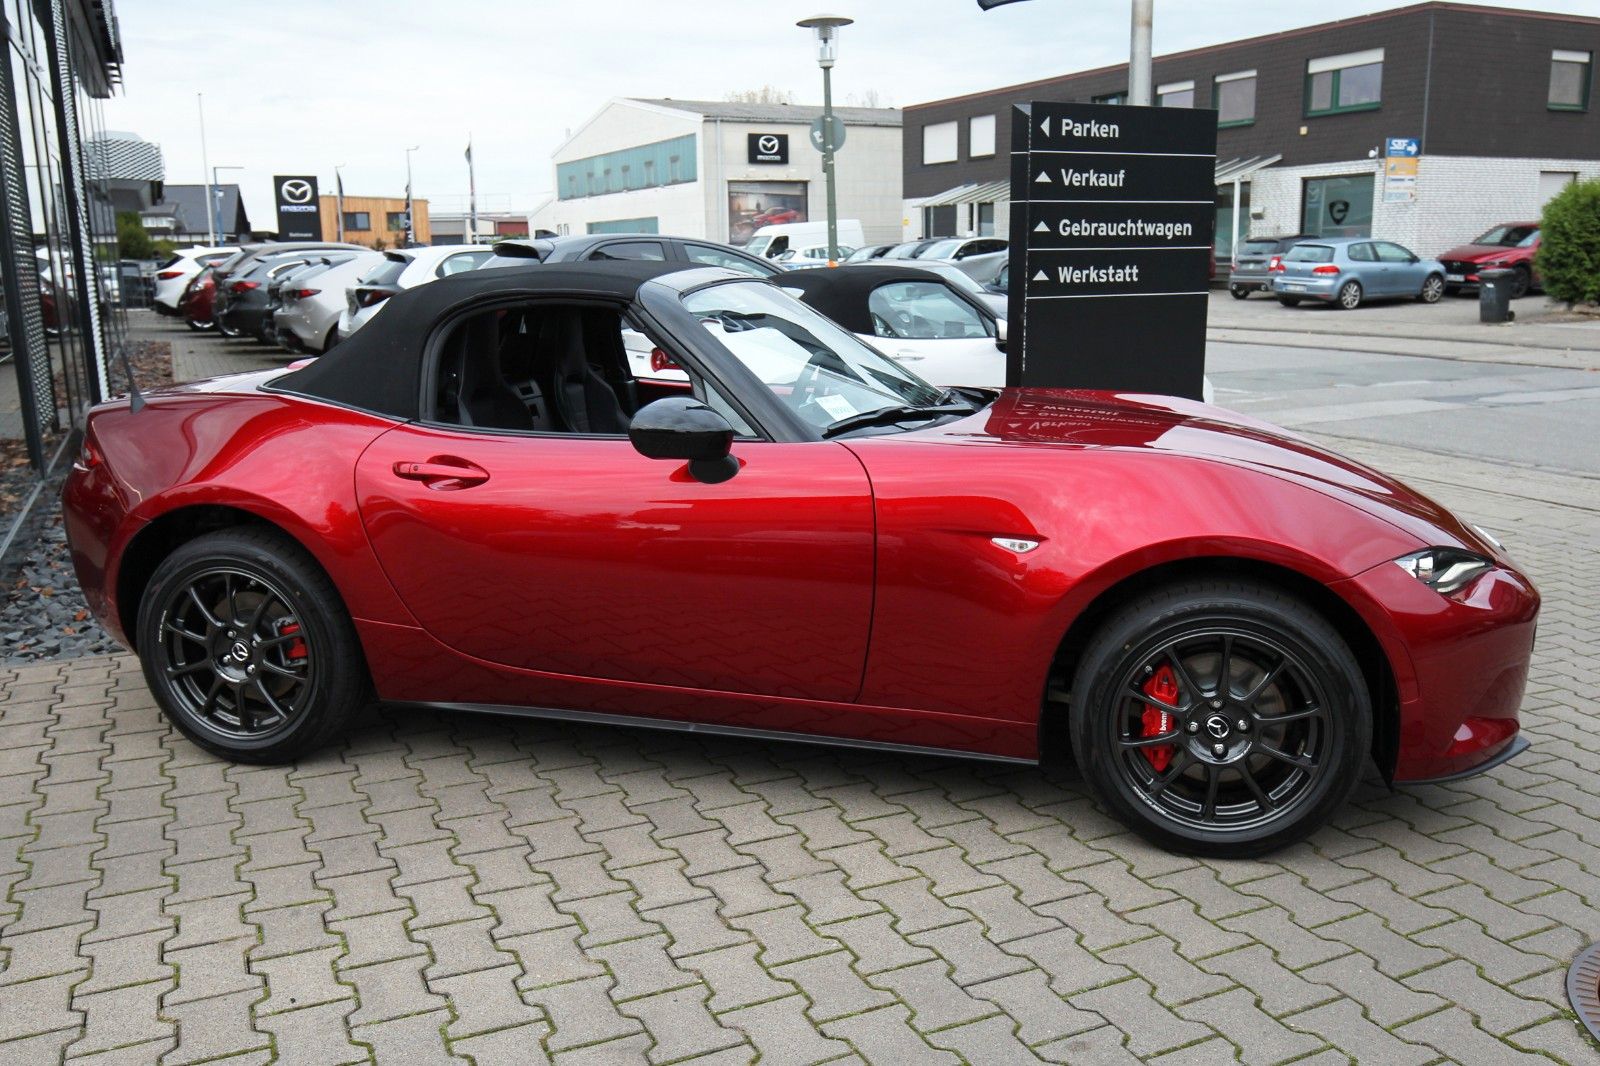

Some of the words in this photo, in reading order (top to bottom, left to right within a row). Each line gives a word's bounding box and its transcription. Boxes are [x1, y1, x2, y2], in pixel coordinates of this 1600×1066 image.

[1062, 119, 1119, 137] Parken
[1061, 169, 1125, 186] Verkauf
[1059, 219, 1192, 239] Gebrauchtwagen
[1058, 265, 1138, 283] Werkstatt
